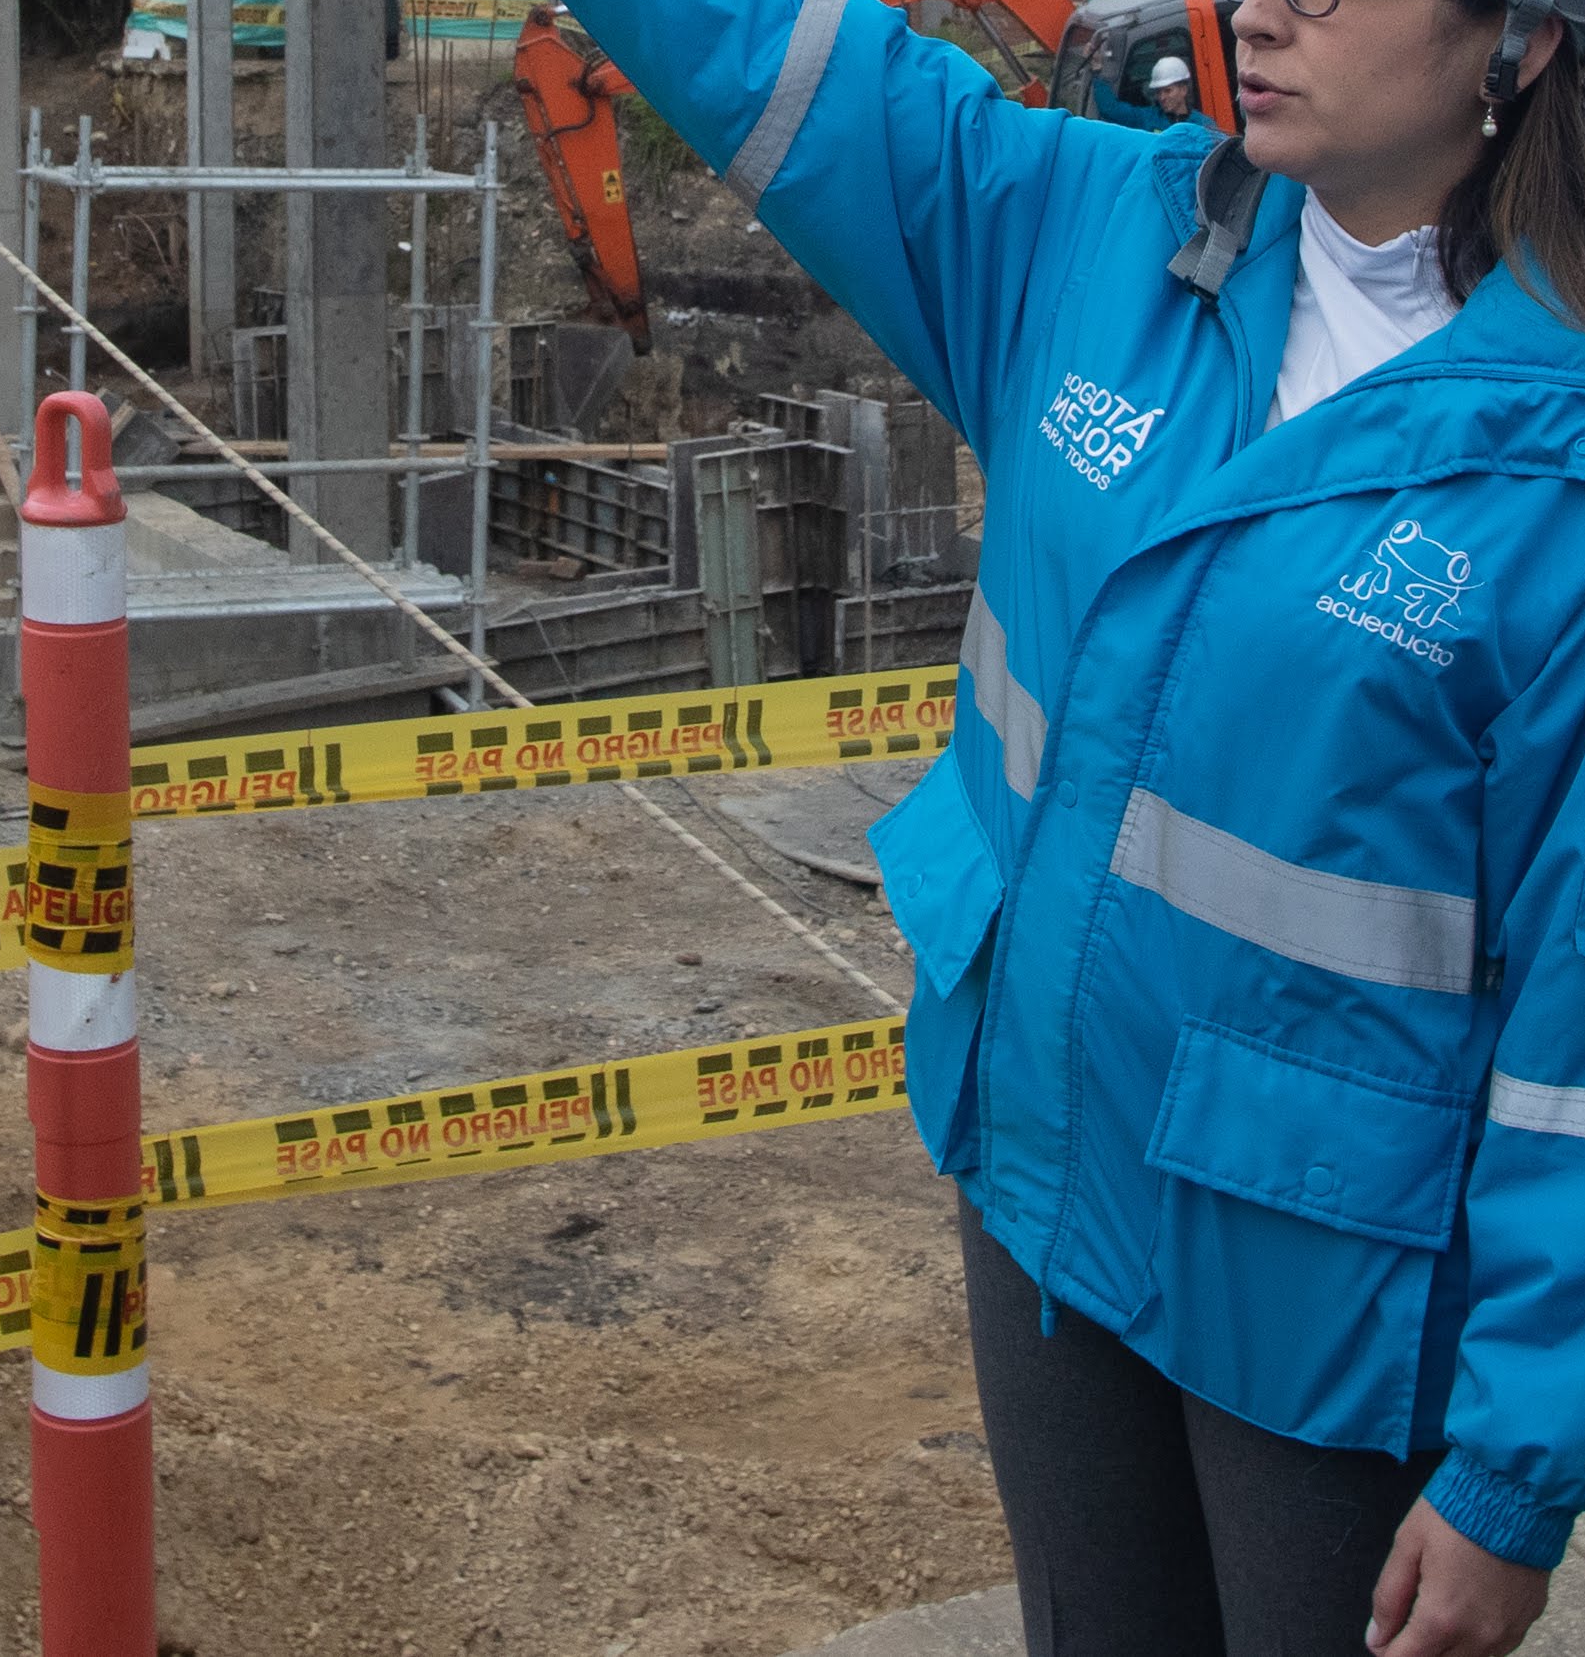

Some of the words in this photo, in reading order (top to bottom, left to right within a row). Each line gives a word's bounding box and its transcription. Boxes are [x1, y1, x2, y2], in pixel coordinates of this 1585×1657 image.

[1047, 387, 1133, 476] MEJOR
[1063, 371, 1166, 452] BOGOTÁ
[1037, 416, 1065, 452] PARA
[1064, 443, 1111, 491] TODOS
[1315, 594, 1455, 667] acueducto
[28, 881, 134, 927] PELIG
